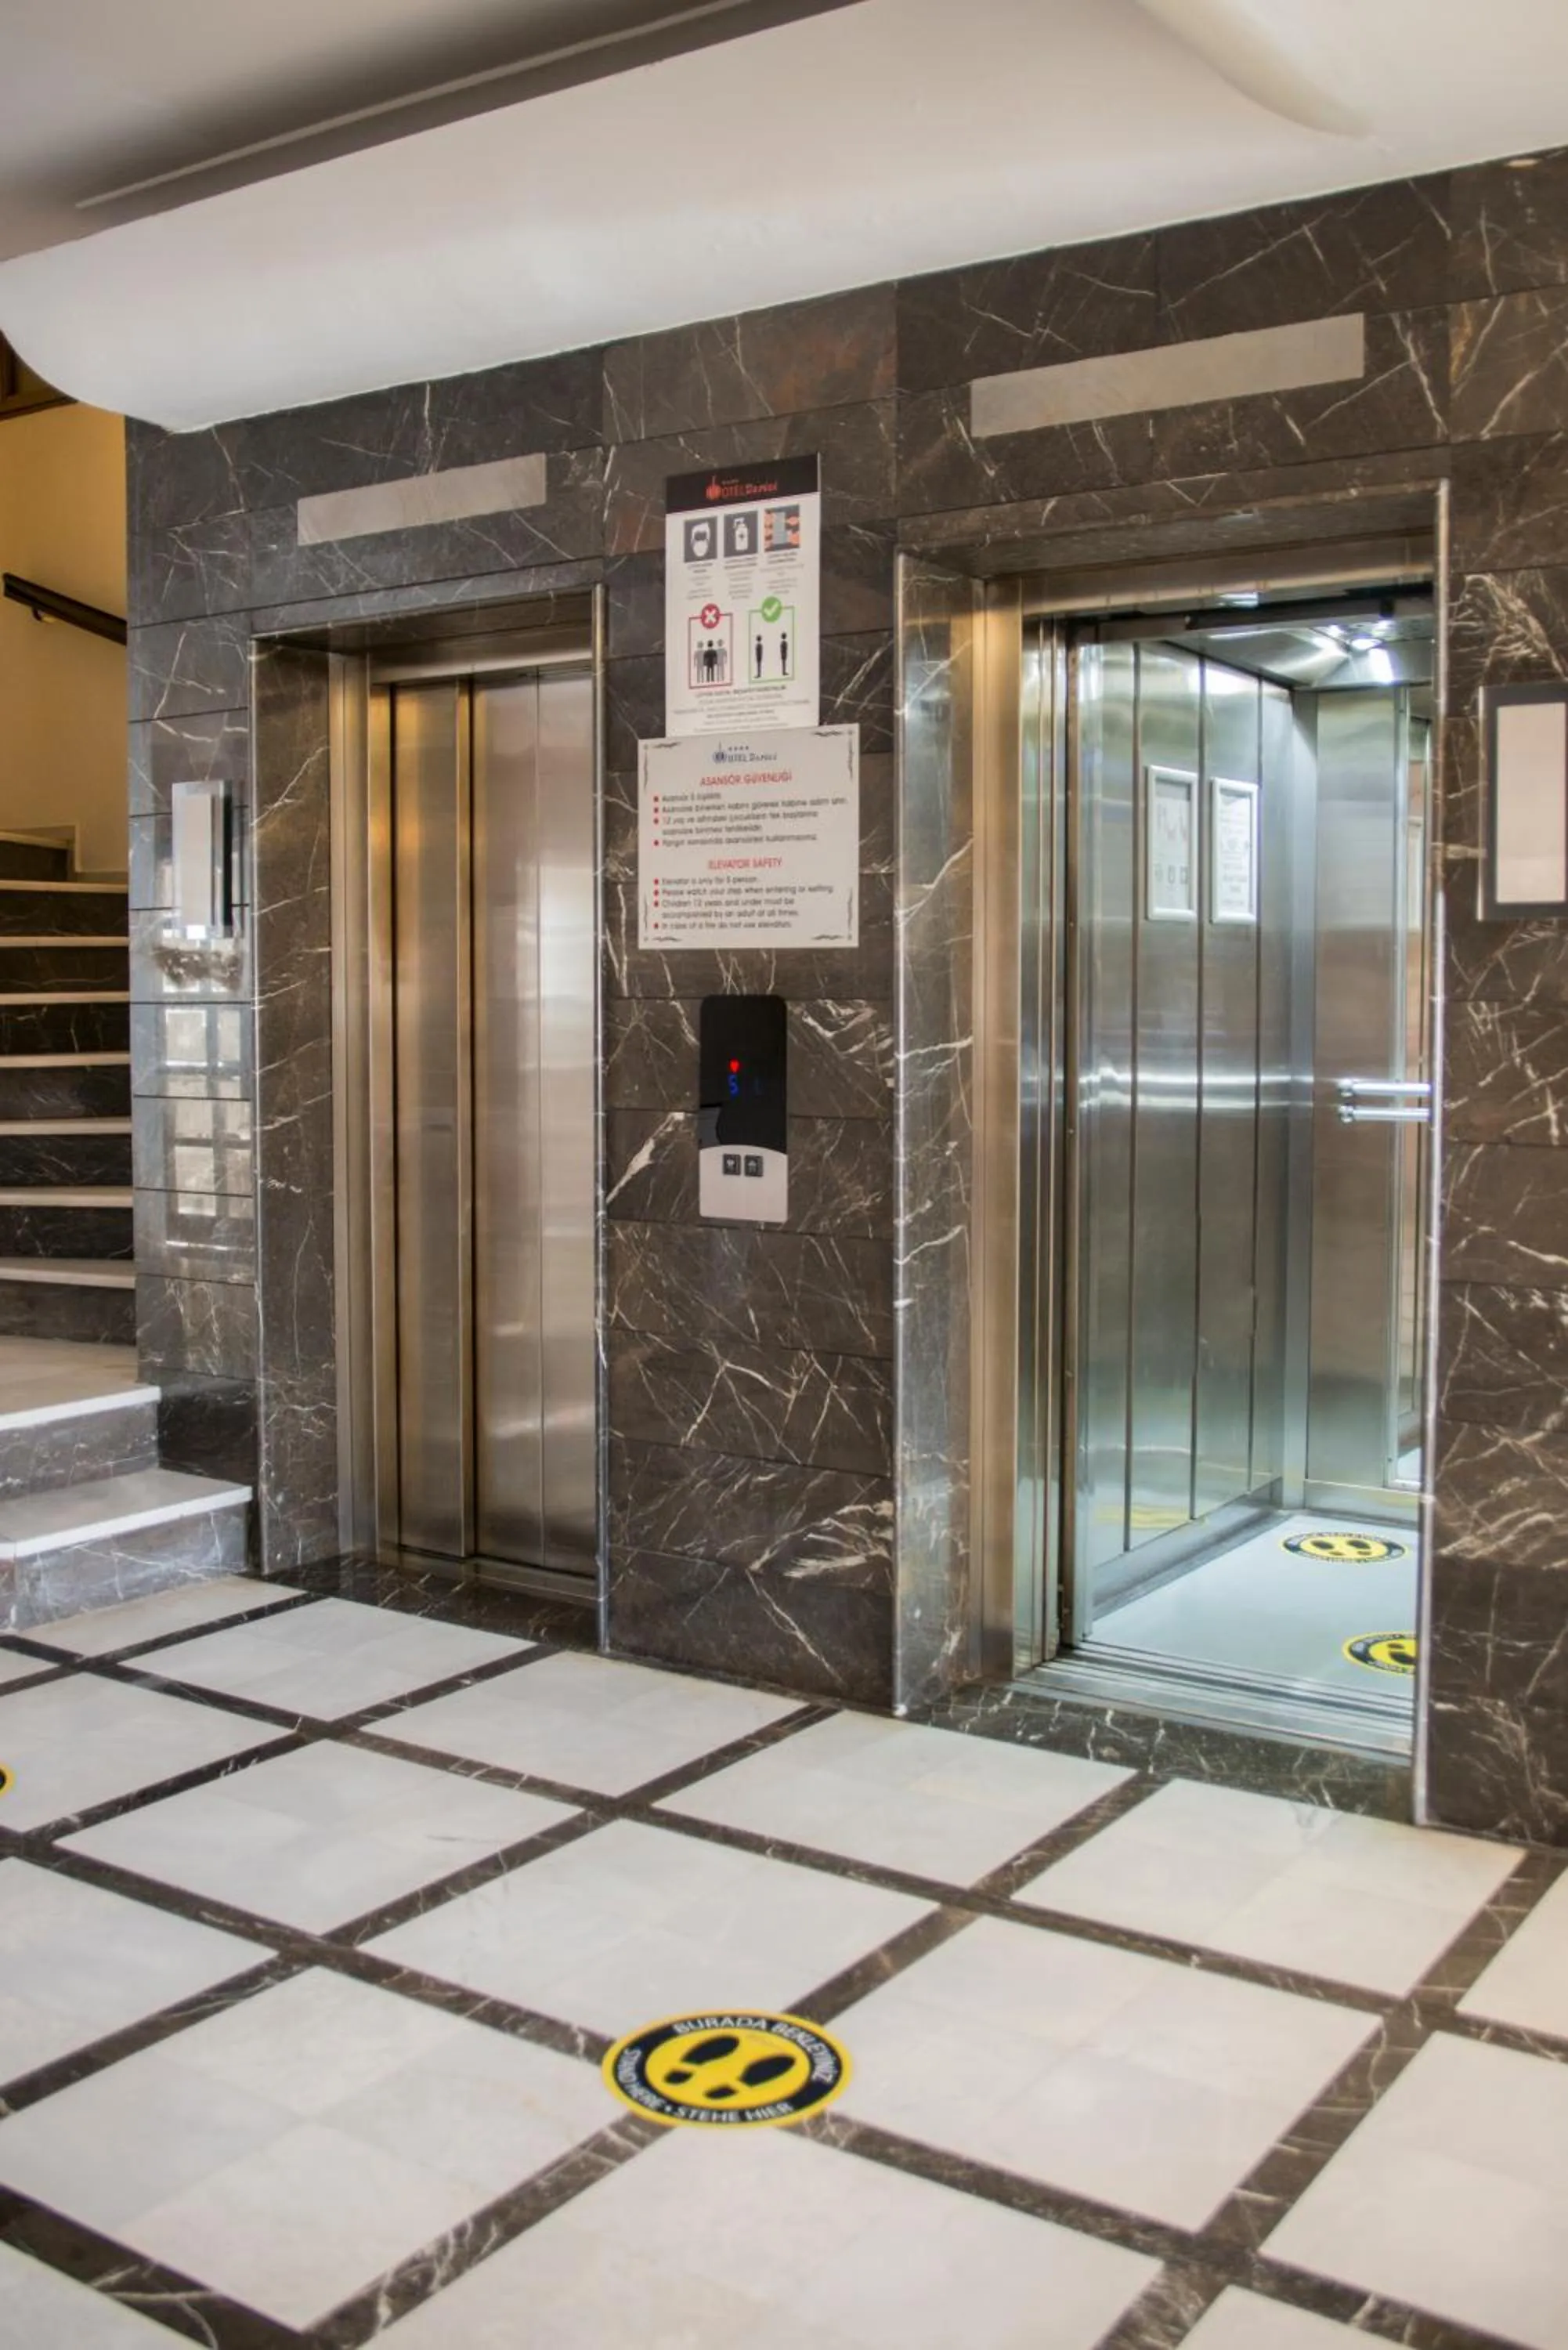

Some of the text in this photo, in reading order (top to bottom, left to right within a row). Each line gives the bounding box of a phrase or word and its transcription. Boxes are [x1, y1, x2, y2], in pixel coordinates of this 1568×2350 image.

[708, 856, 782, 870] ELEVATOR SAFETY
[672, 2016, 768, 2034] BURADA
[674, 2106, 741, 2123] STEHE
[743, 2102, 793, 2120] HIER
